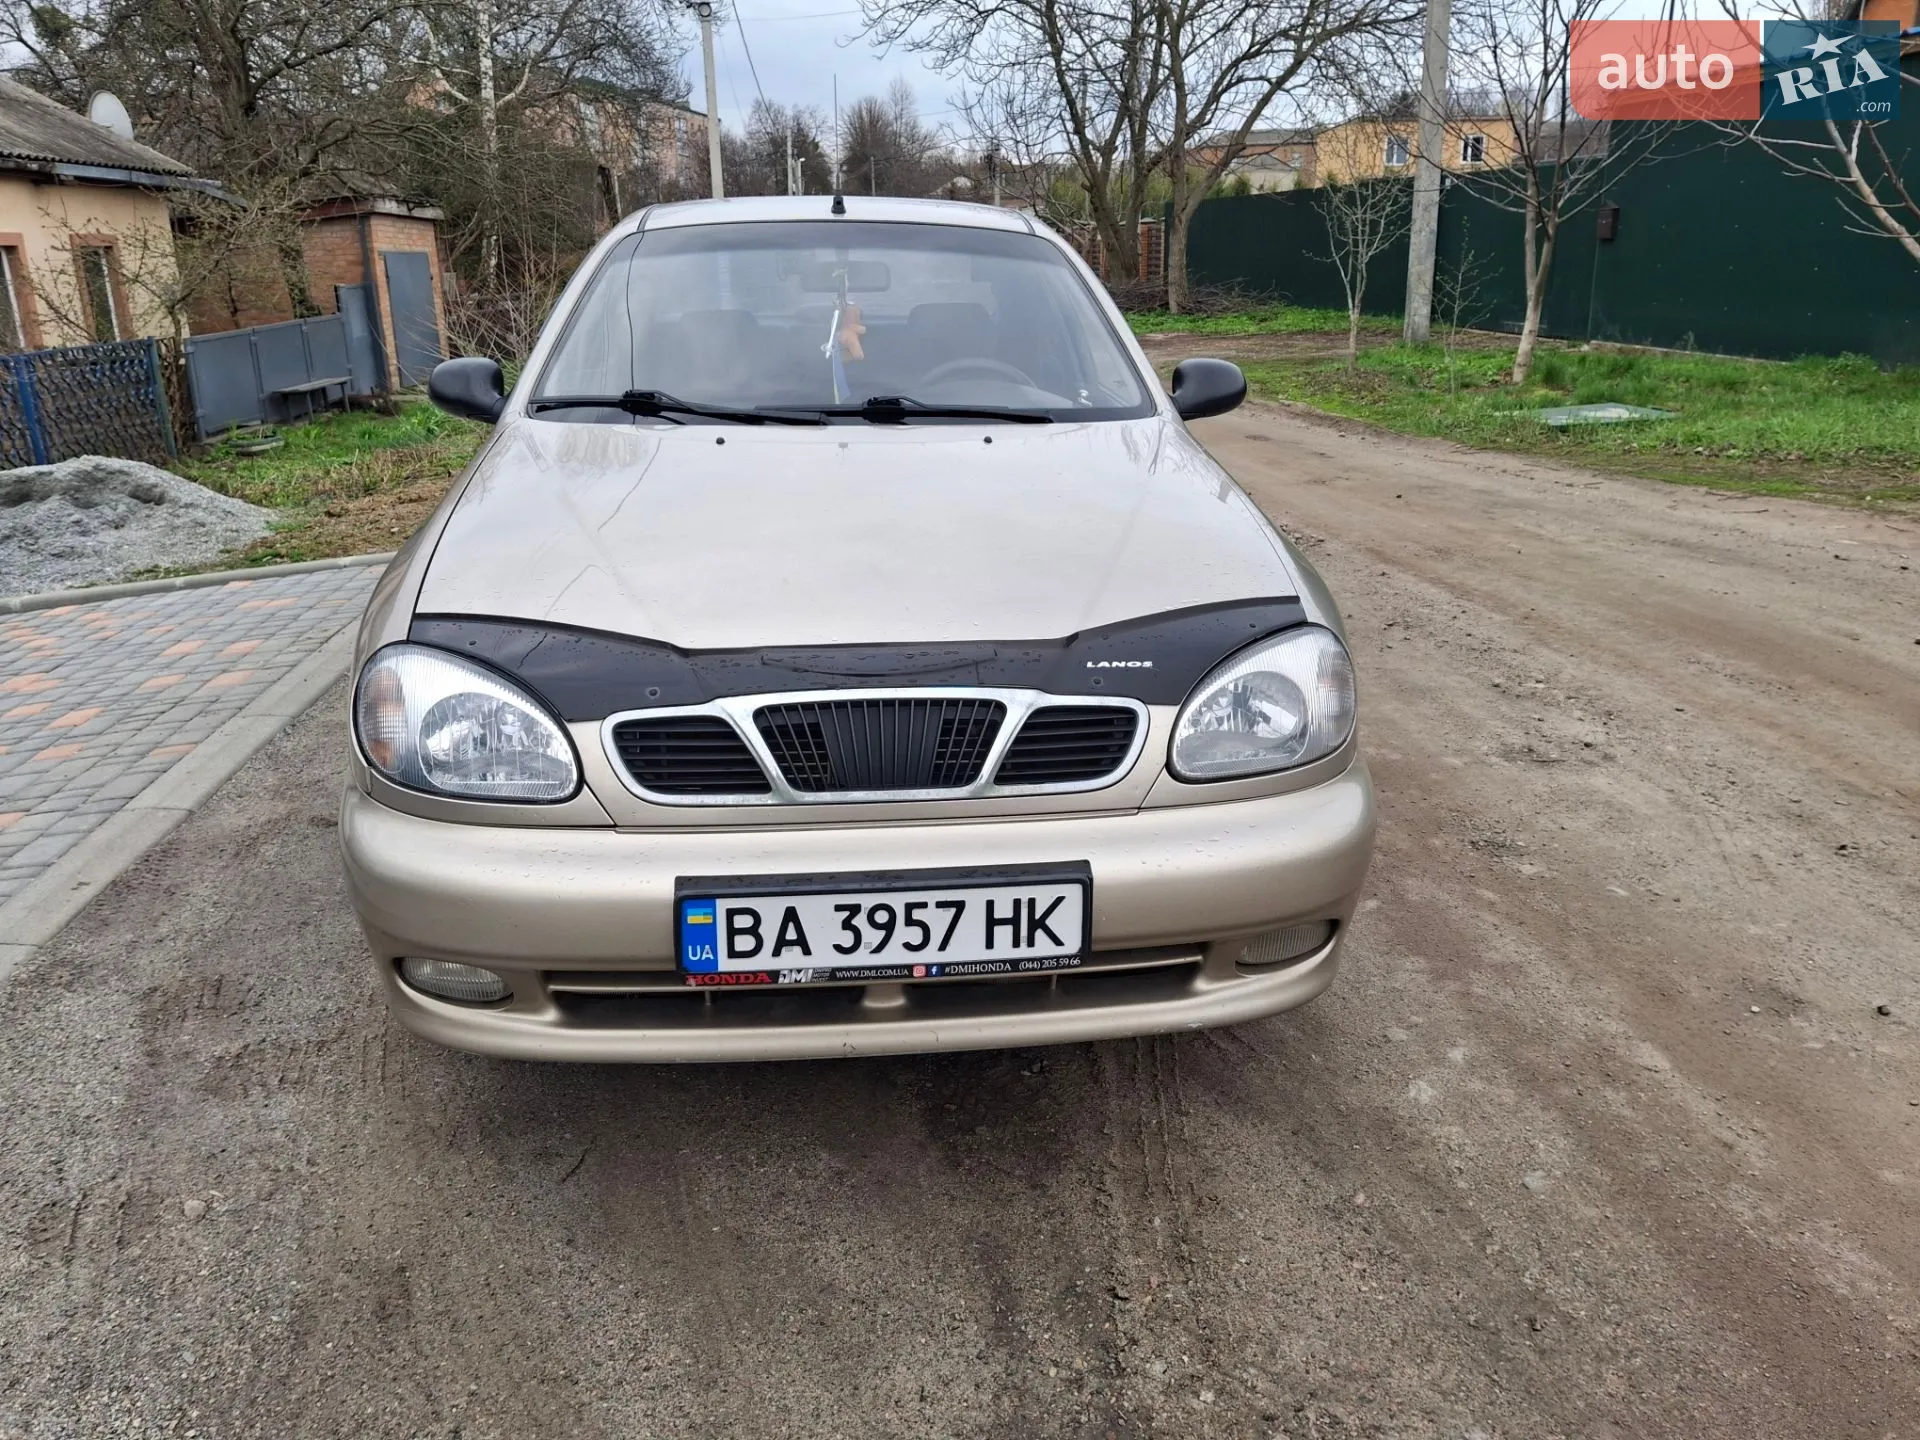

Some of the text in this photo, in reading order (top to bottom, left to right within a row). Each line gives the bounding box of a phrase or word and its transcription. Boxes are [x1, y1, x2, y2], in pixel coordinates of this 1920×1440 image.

[726, 896, 1066, 958] BA 3957 HK
[688, 945, 714, 961] UA
[945, 962, 1011, 974] #DMIHONDA
[1019, 961, 1040, 971] (044)
[1042, 959, 1057, 968] 205
[1059, 958, 1069, 967] 59
[1070, 956, 1081, 965] 66
[685, 968, 813, 985] HONDA DMI
